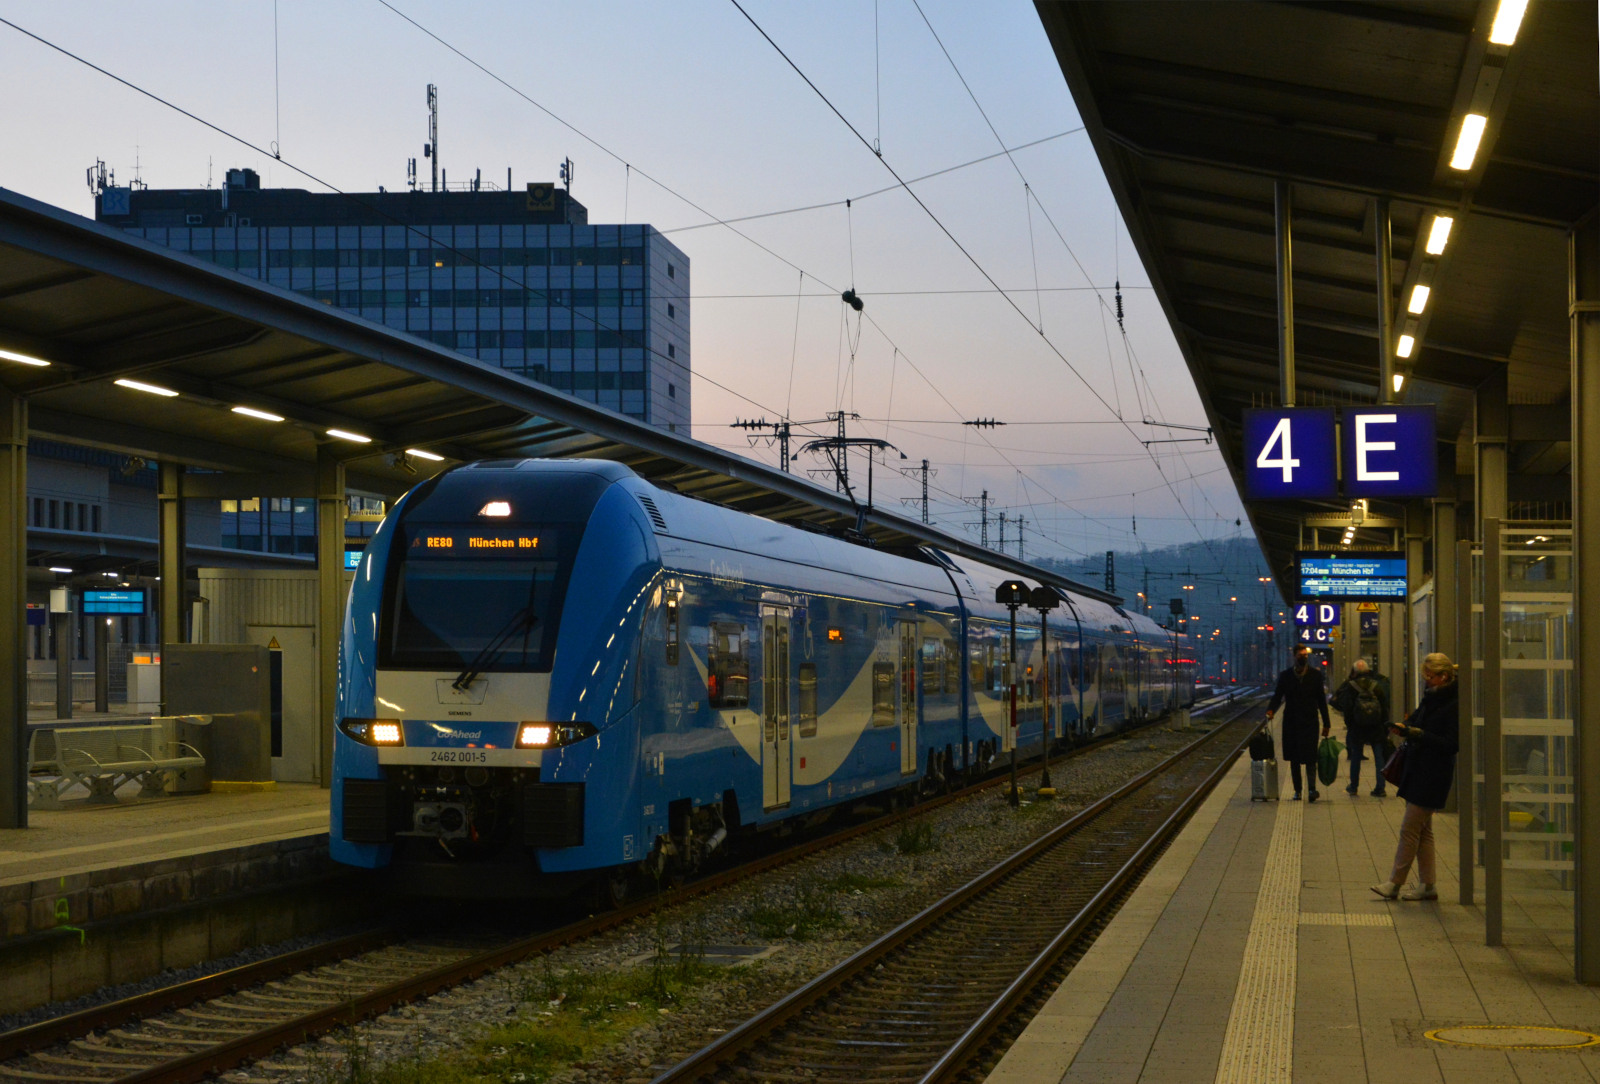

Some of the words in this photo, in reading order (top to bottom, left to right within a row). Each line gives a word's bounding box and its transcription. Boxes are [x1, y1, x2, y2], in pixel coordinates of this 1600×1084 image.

[103, 191, 127, 211] BR
[1256, 417, 1301, 483] 4
[1355, 413, 1400, 482] E
[427, 537, 453, 548] RE80
[469, 537, 515, 548] München
[518, 537, 539, 548] Hbf
[1300, 567, 1319, 575] 17:04
[1332, 567, 1361, 575] München
[1362, 567, 1374, 575] Hbf
[1296, 604, 1309, 623] 4
[1319, 604, 1335, 623] D
[1302, 629, 1311, 641] 4
[1316, 628, 1326, 641] C
[431, 751, 456, 762] 2462
[458, 752, 487, 763] 001-5
